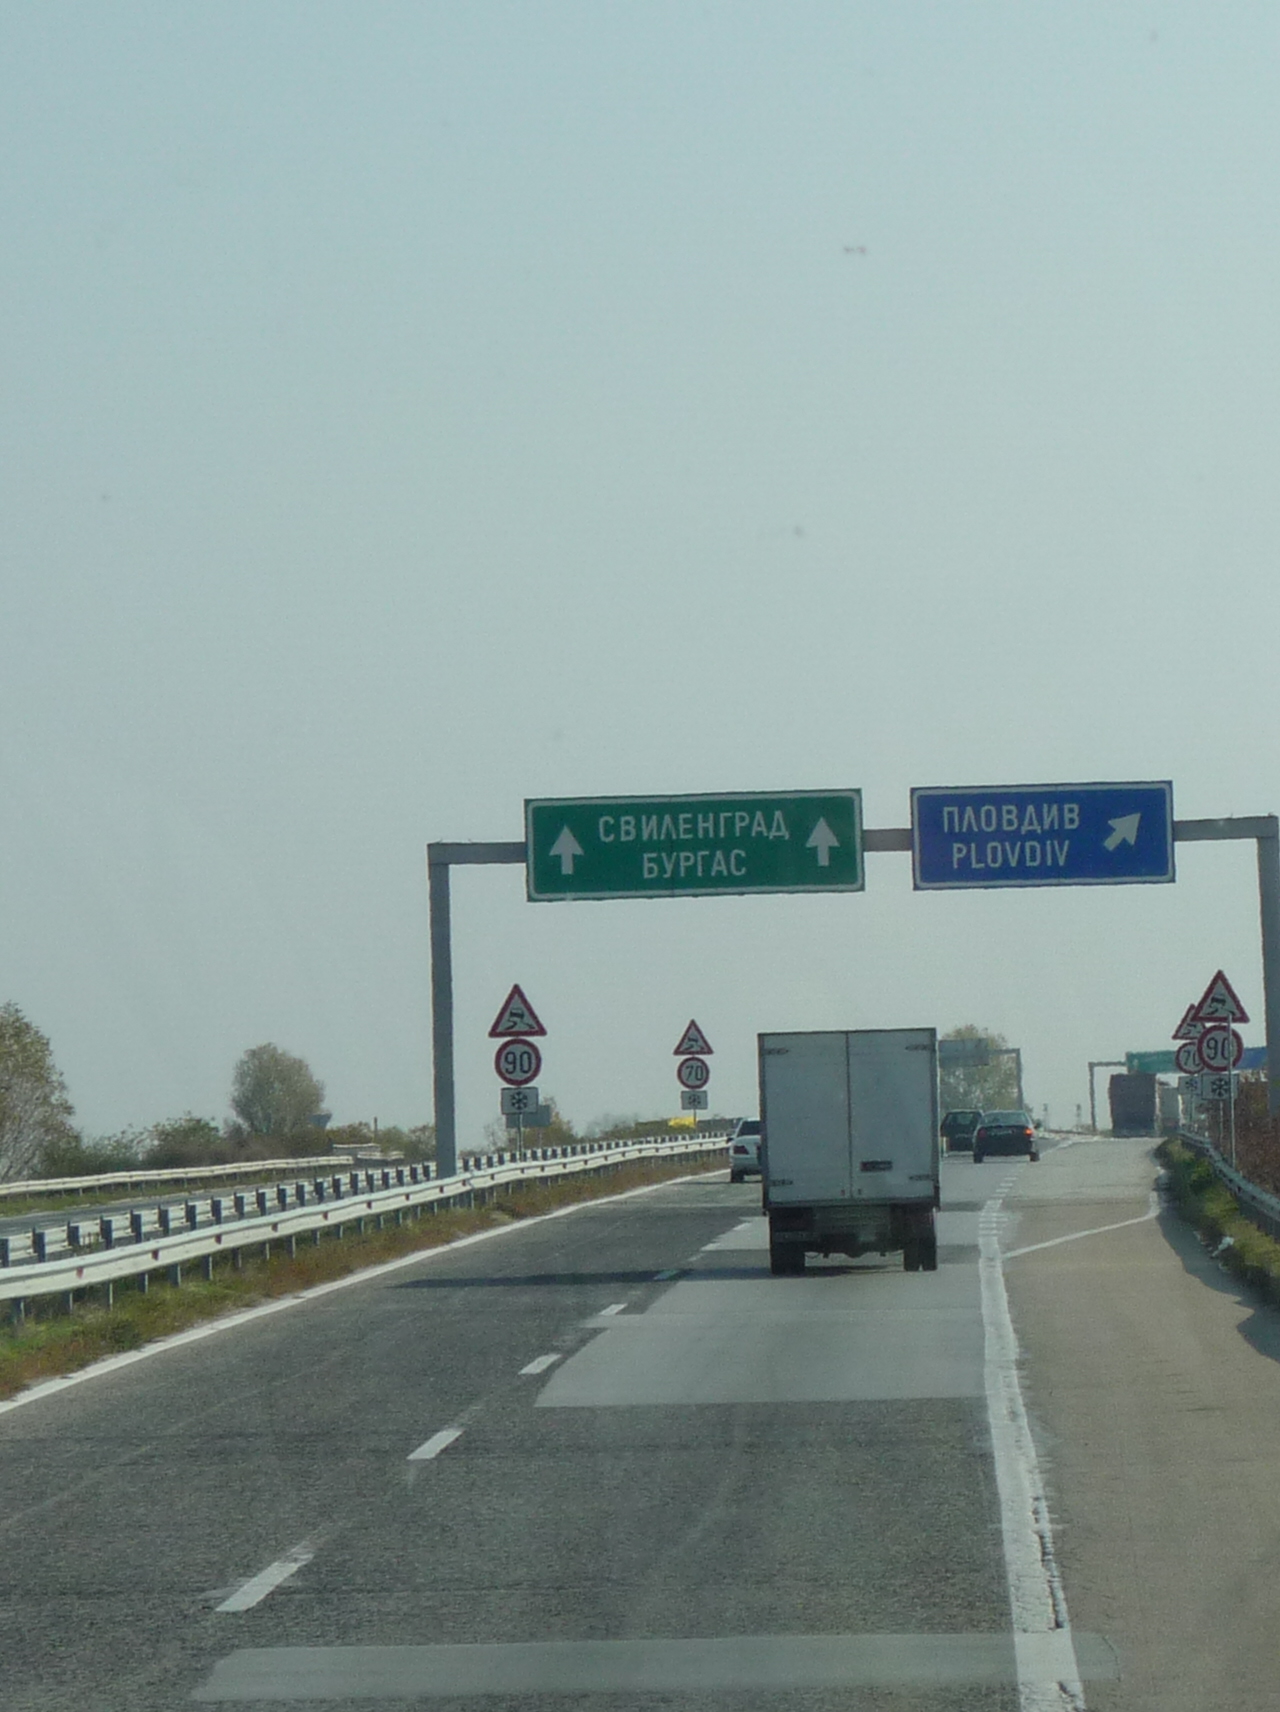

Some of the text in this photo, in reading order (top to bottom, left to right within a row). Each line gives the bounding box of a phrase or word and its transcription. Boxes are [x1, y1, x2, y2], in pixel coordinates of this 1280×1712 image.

[598, 811, 790, 842] СВИЛЕНГРАД
[943, 804, 1080, 835] ПЛОВДИВ
[642, 849, 747, 879] БУРГАС
[953, 840, 1069, 869] PLOVDIV
[504, 1050, 532, 1075] 90
[685, 1065, 704, 1081] 70
